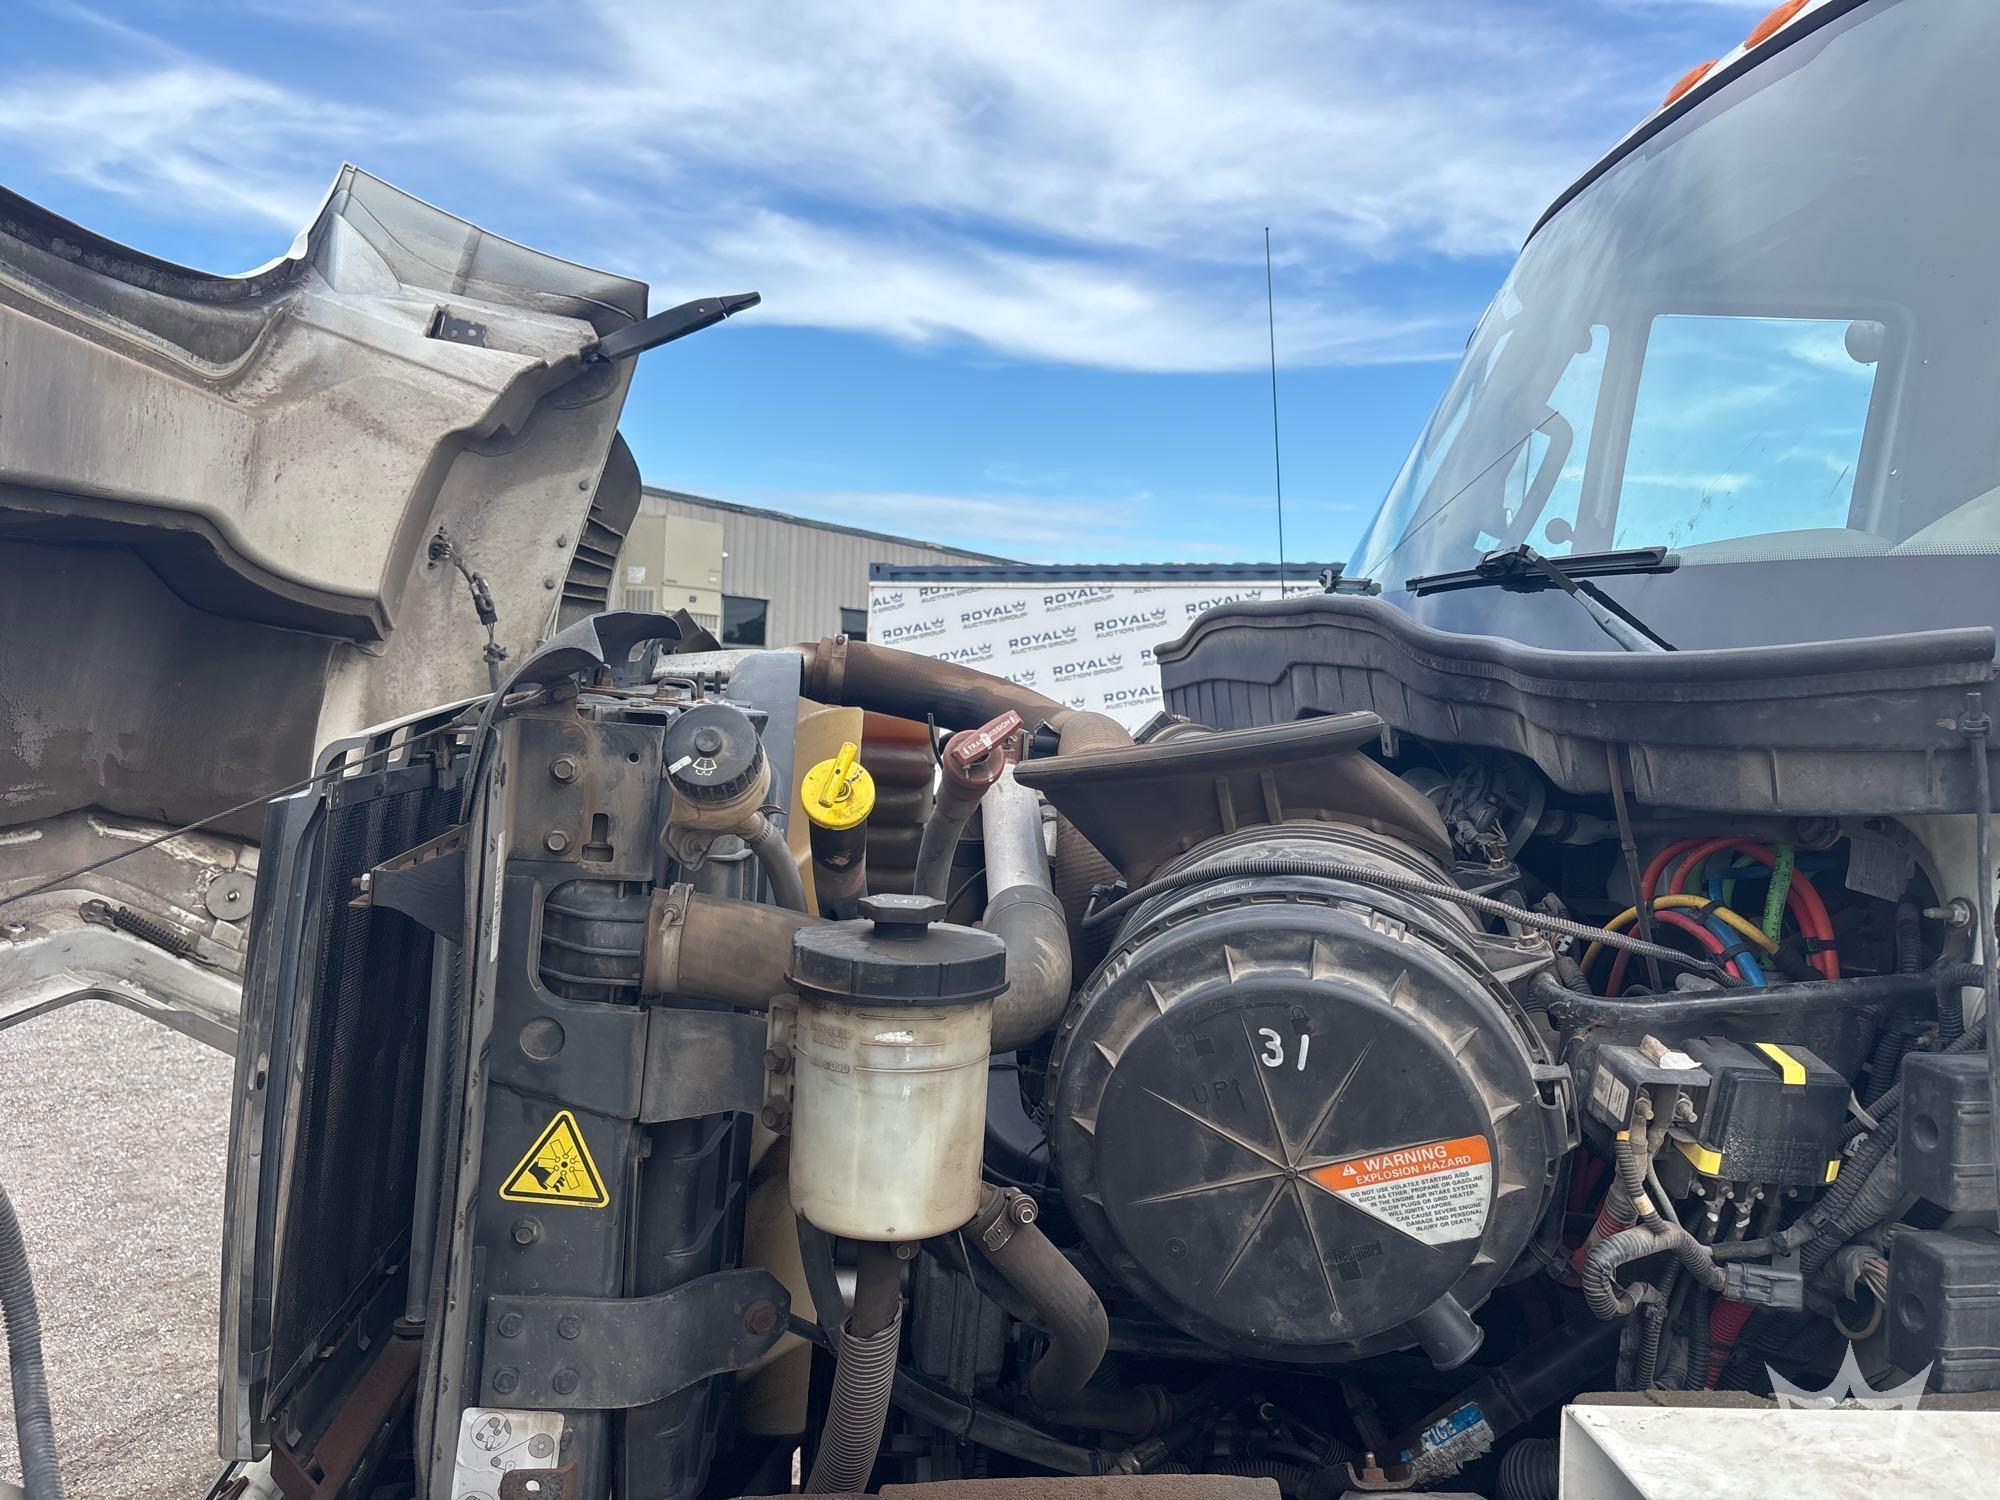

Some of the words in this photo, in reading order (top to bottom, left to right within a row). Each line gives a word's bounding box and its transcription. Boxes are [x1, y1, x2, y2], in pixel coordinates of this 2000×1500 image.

[1044, 587, 1098, 606] ROYAL
[1045, 601, 1082, 613] AUCTION
[1083, 594, 1115, 605] GROUP
[961, 605, 1013, 623] ROYAL
[1094, 613, 1151, 632] ROYAL
[882, 621, 931, 640] ROYAL
[962, 619, 998, 629] AUCTION
[1096, 627, 1135, 639] AUCTION
[1135, 620, 1168, 632] GROUP
[1008, 631, 1062, 649] ROYAL
[1010, 644, 1047, 656] AUCTION
[1048, 638, 1079, 648] GROUP
[1052, 658, 1107, 676] ROYAL
[1055, 672, 1092, 682] AUCTION
[1093, 665, 1124, 676] GROUP
[1103, 685, 1160, 703] ROYAL
[1105, 698, 1144, 710] AUCTION
[1258, 1027, 1310, 1071] 31
[1363, 1145, 1447, 1172] WARNING
[1356, 1165, 1419, 1184] EXPLOSION
[1423, 1155, 1472, 1172] HAZARD
[1390, 1181, 1419, 1190] VOLATILE
[1421, 1175, 1452, 1184] STARTING
[1411, 1184, 1440, 1193] PROPANE
[1452, 1176, 1483, 1185] GASOLINE
[1392, 1195, 1414, 1203] ENGINE
[1429, 1188, 1451, 1196] INTAKE
[1450, 1191, 1474, 1199] HEATER
[1405, 1206, 1424, 1214] IGNITE
[1434, 1207, 1456, 1215] SEVERE
[1459, 1202, 1482, 1211] ENGINE
[1406, 1218, 1433, 1227] DAMAGE
[1451, 1209, 1483, 1219] PERSONAL
[1416, 1223, 1438, 1232] INJURY
